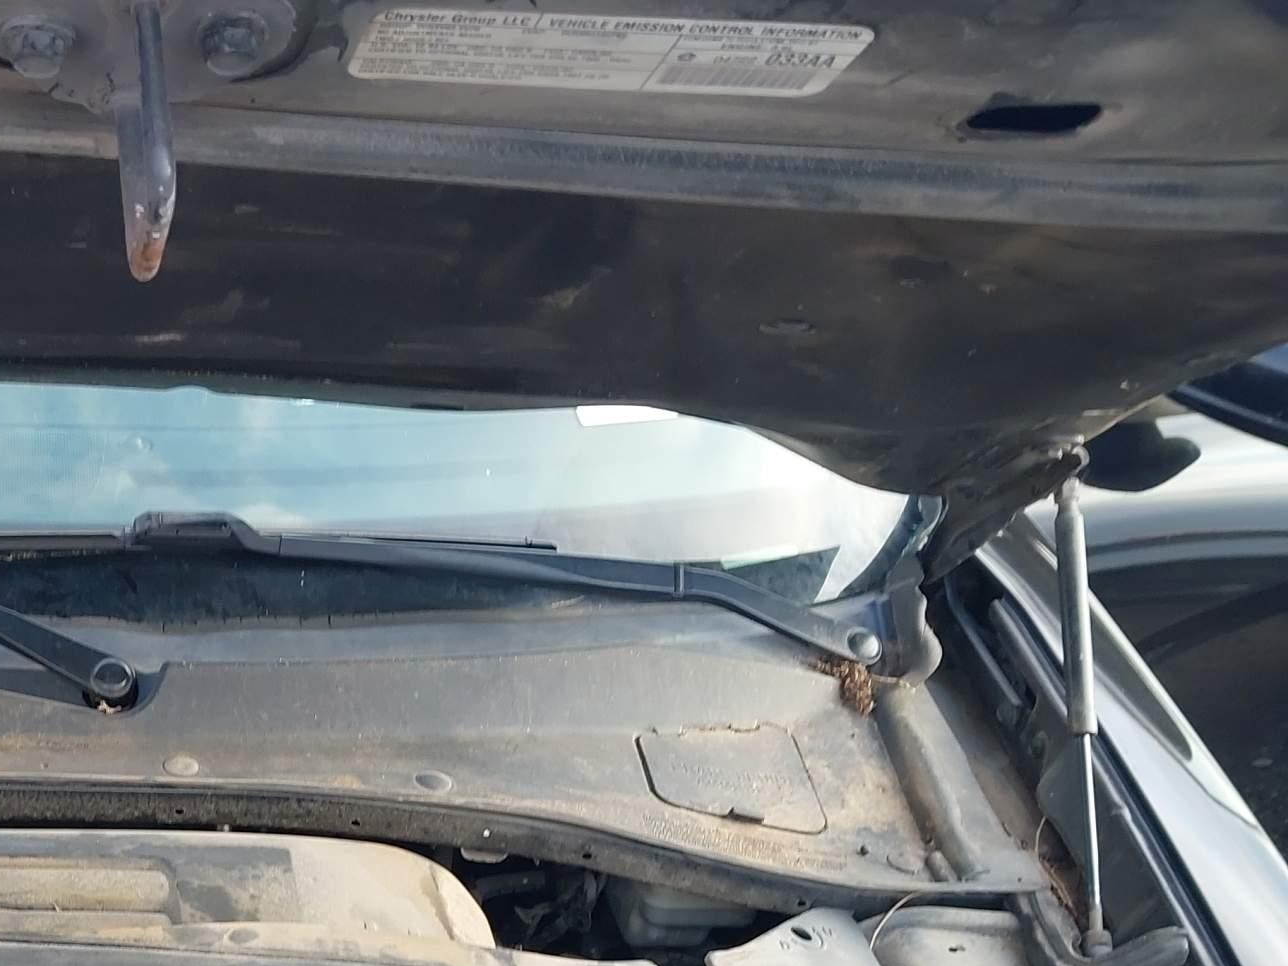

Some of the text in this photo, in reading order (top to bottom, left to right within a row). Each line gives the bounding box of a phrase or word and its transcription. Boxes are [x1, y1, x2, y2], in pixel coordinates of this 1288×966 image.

[384, 11, 532, 26] Chrysler Group LLC
[549, 19, 863, 40] VEHICLE EMISSION CONTROL INFORMATION
[765, 53, 837, 68] 033AA
